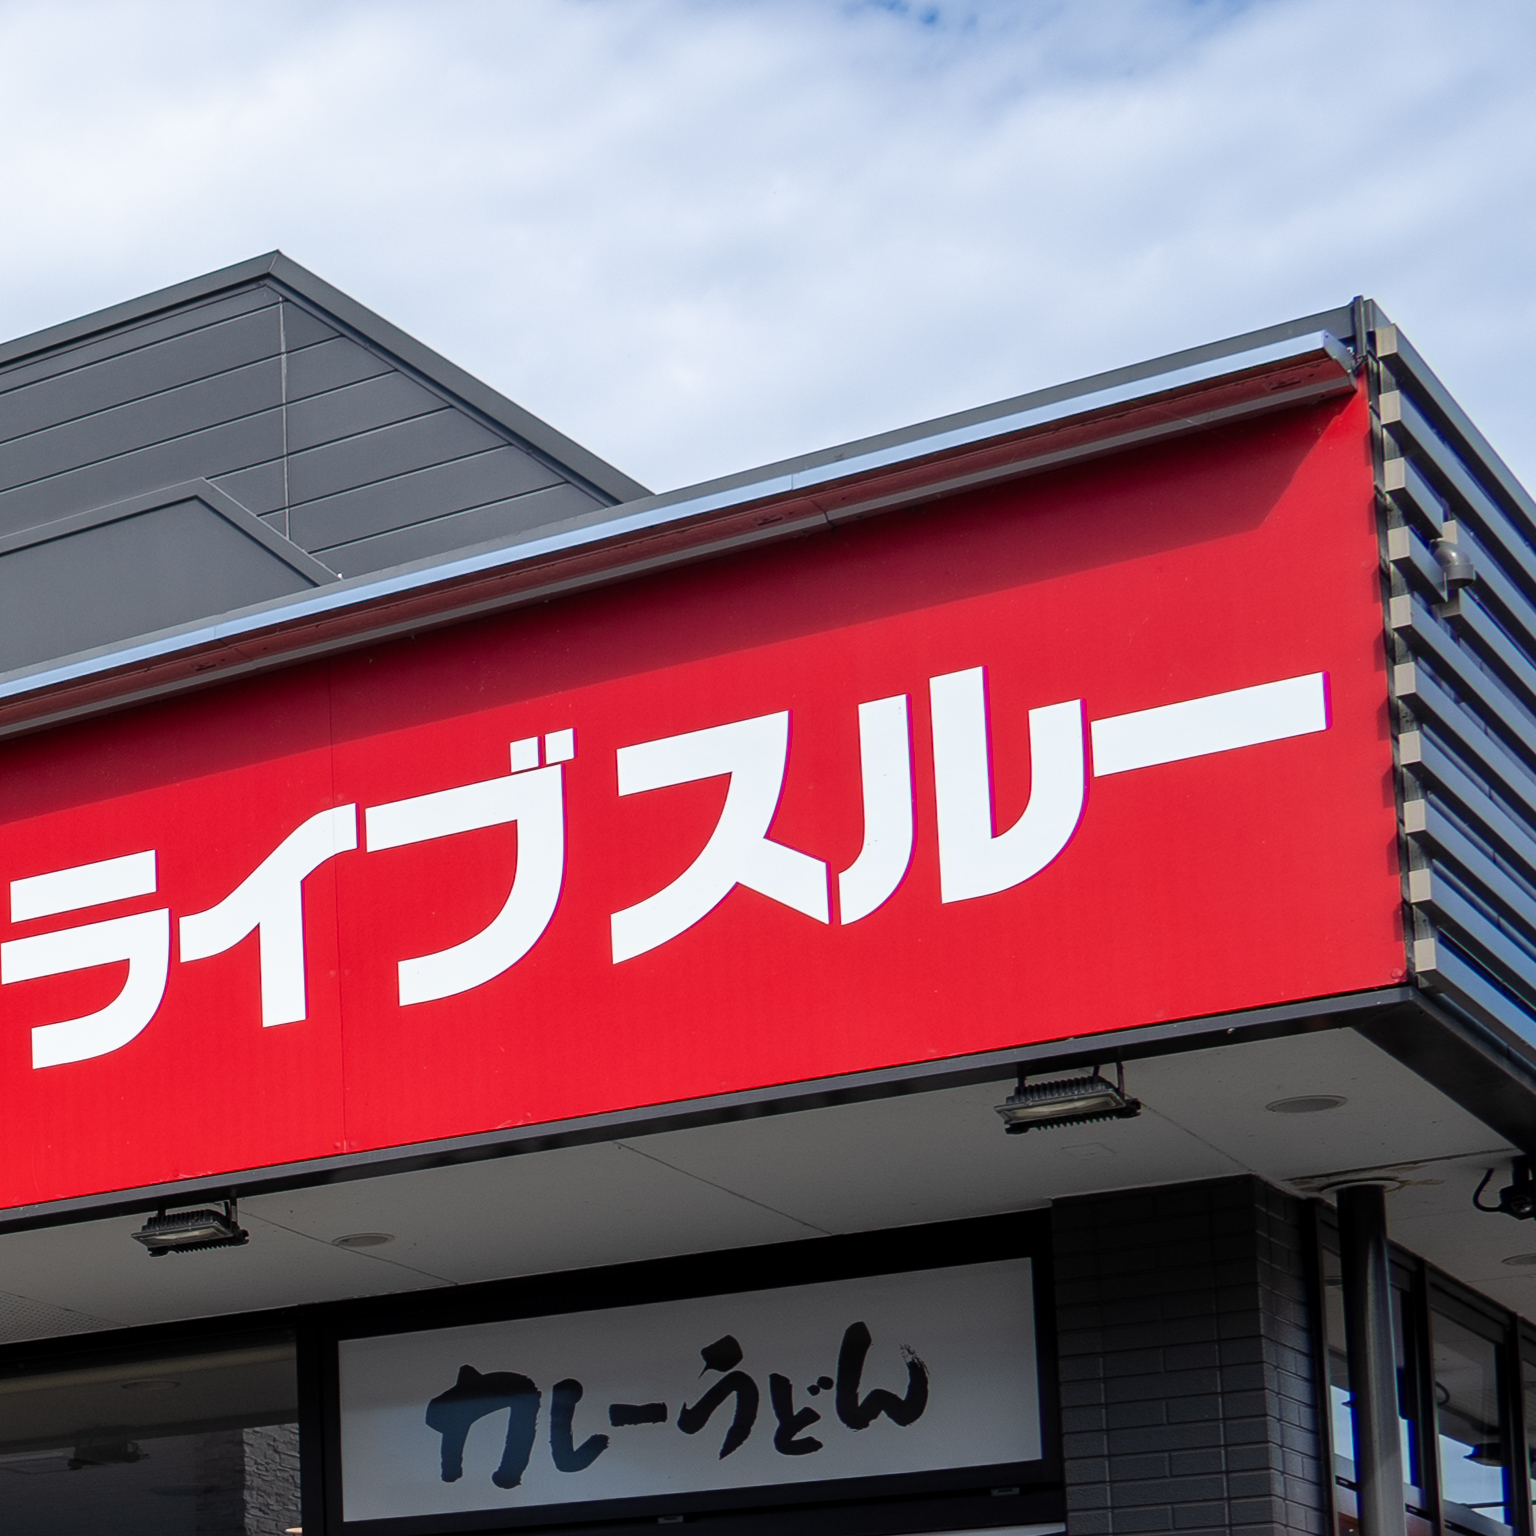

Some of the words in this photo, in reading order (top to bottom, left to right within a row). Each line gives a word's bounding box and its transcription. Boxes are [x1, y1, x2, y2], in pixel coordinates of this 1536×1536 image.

[425, 1320, 930, 1489] カレーうどん
